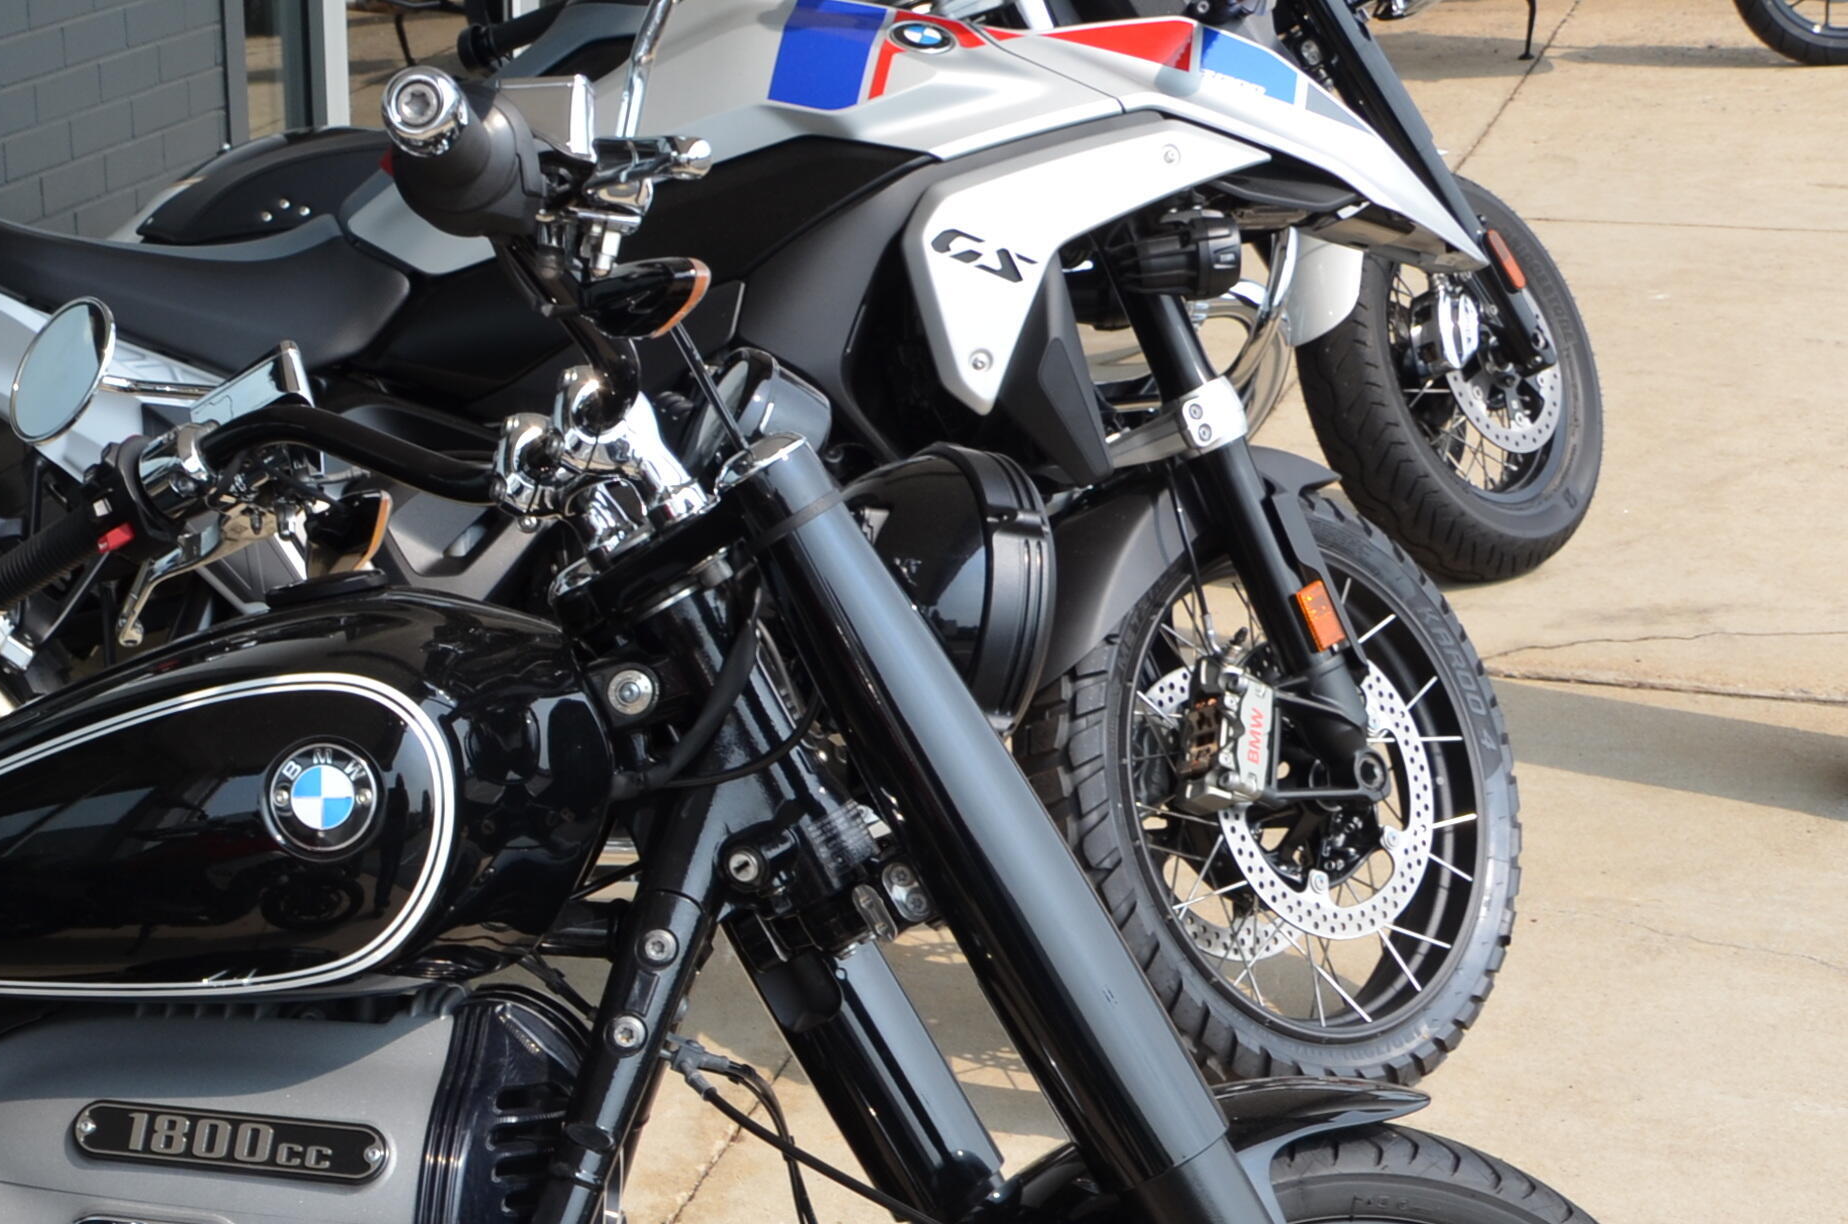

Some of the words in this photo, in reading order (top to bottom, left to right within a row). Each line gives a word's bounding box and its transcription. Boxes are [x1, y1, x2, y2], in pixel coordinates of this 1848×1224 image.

[930, 228, 1039, 283] GS
[1418, 606, 1487, 716] KAROO
[1478, 728, 1497, 751] 4
[282, 748, 366, 781] BMW
[1245, 707, 1266, 765] BMW
[127, 1112, 333, 1170] 1800cc
